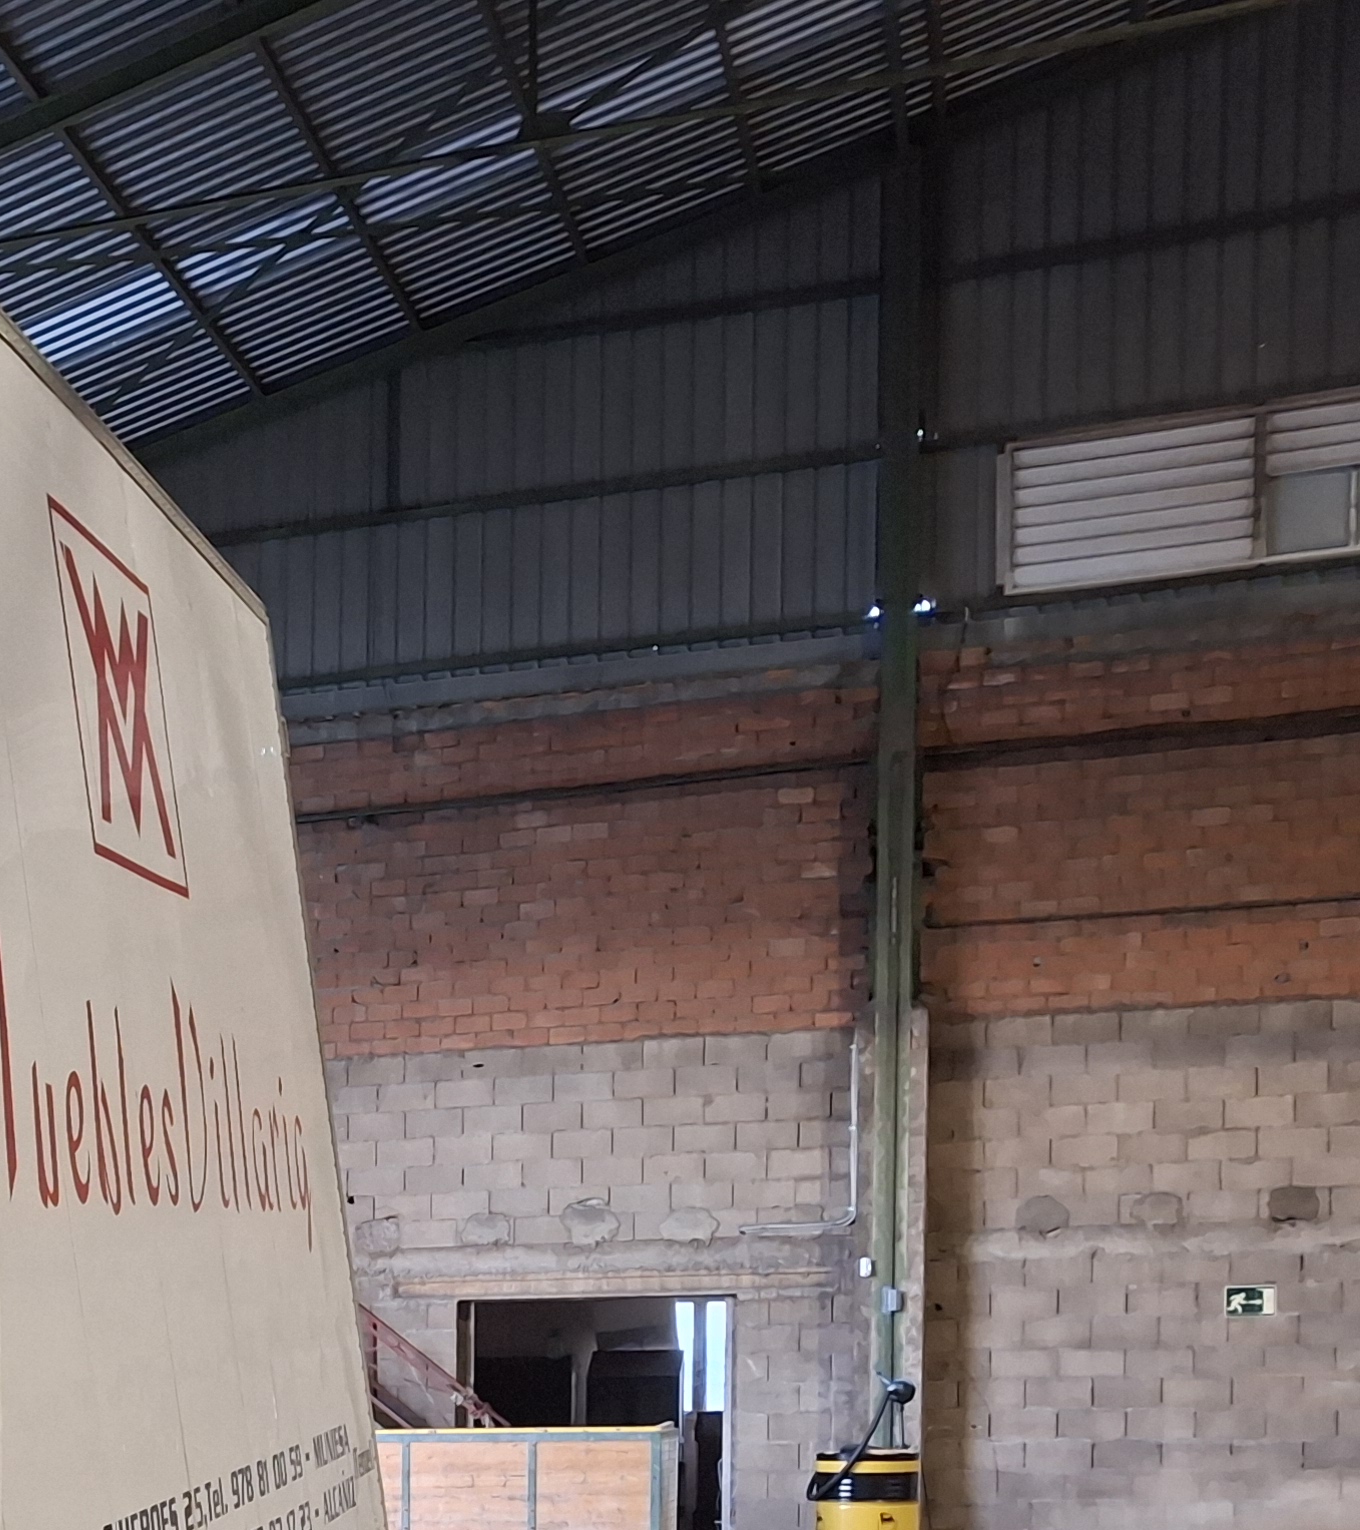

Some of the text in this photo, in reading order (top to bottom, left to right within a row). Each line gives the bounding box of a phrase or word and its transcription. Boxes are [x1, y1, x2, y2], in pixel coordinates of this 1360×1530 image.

[230, 1465, 254, 1510] 978
[257, 1459, 271, 1497] 81
[272, 1451, 288, 1490] 00
[288, 1444, 304, 1482] 59
